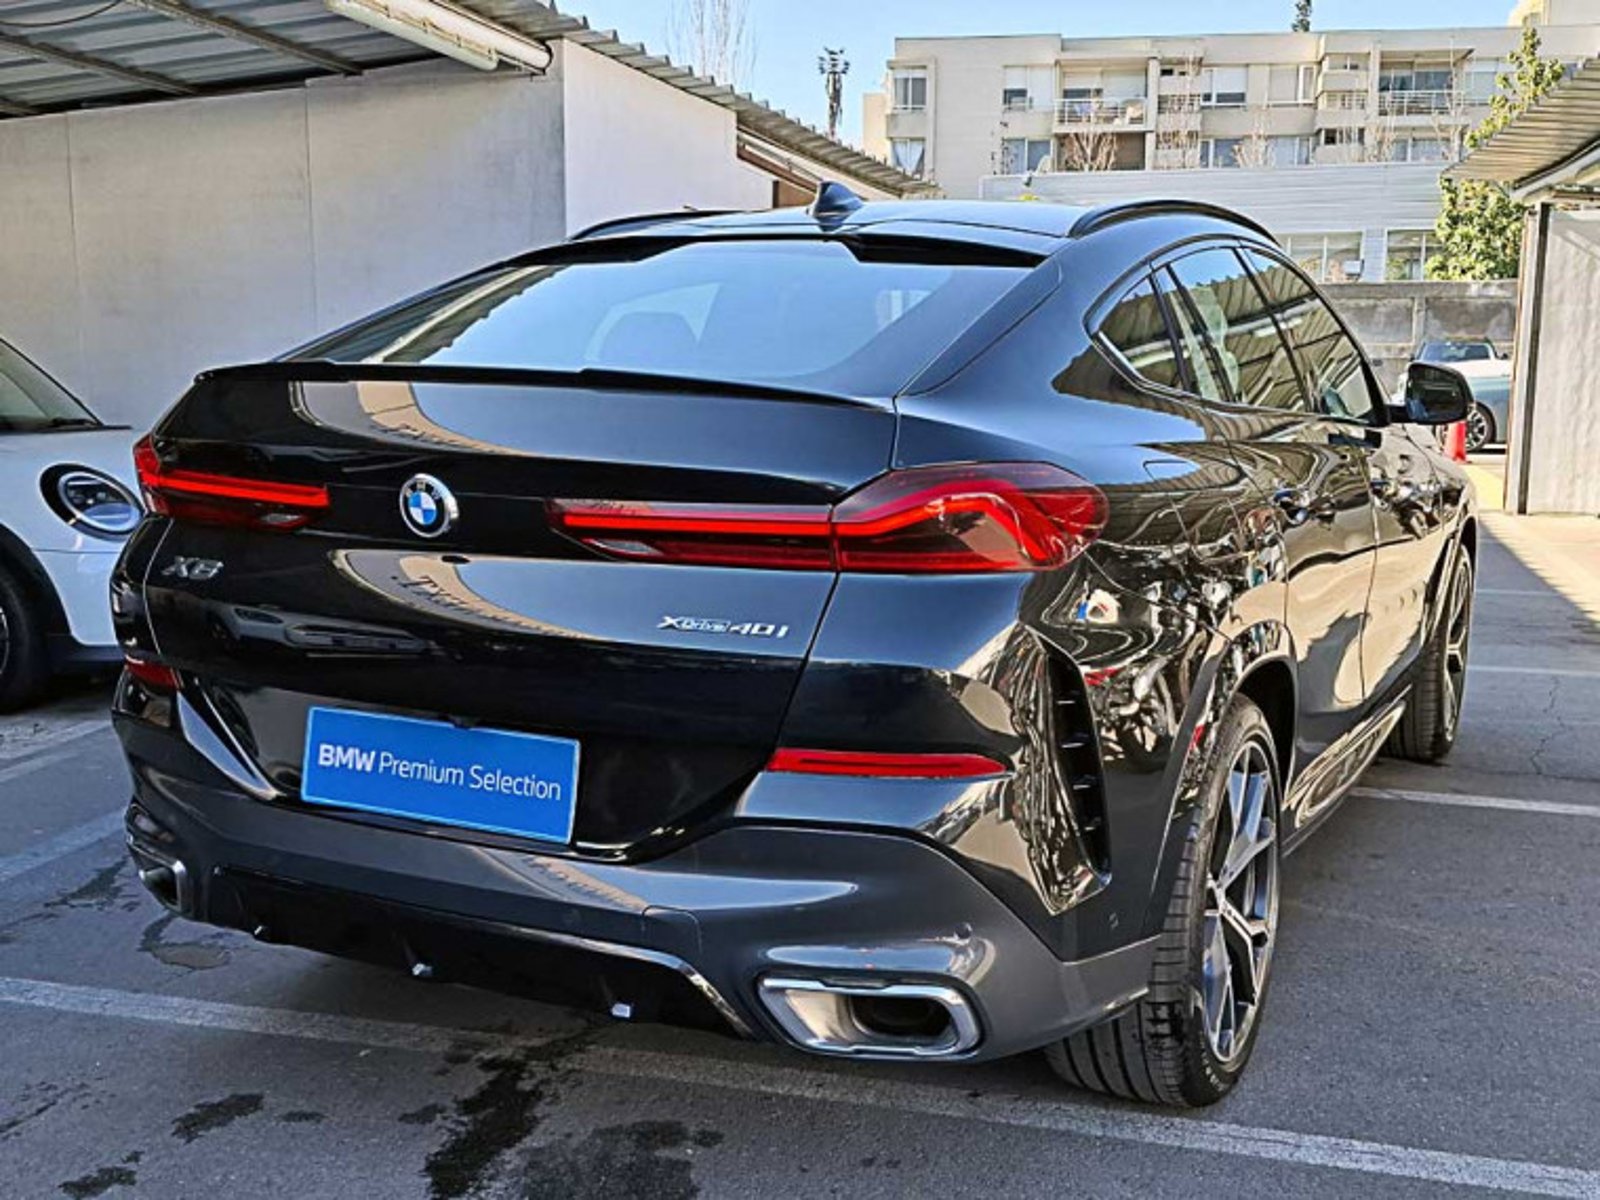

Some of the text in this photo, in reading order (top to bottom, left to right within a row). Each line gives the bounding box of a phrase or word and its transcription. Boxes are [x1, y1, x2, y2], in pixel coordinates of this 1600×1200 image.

[318, 743, 562, 801] BMW Premium Selection
